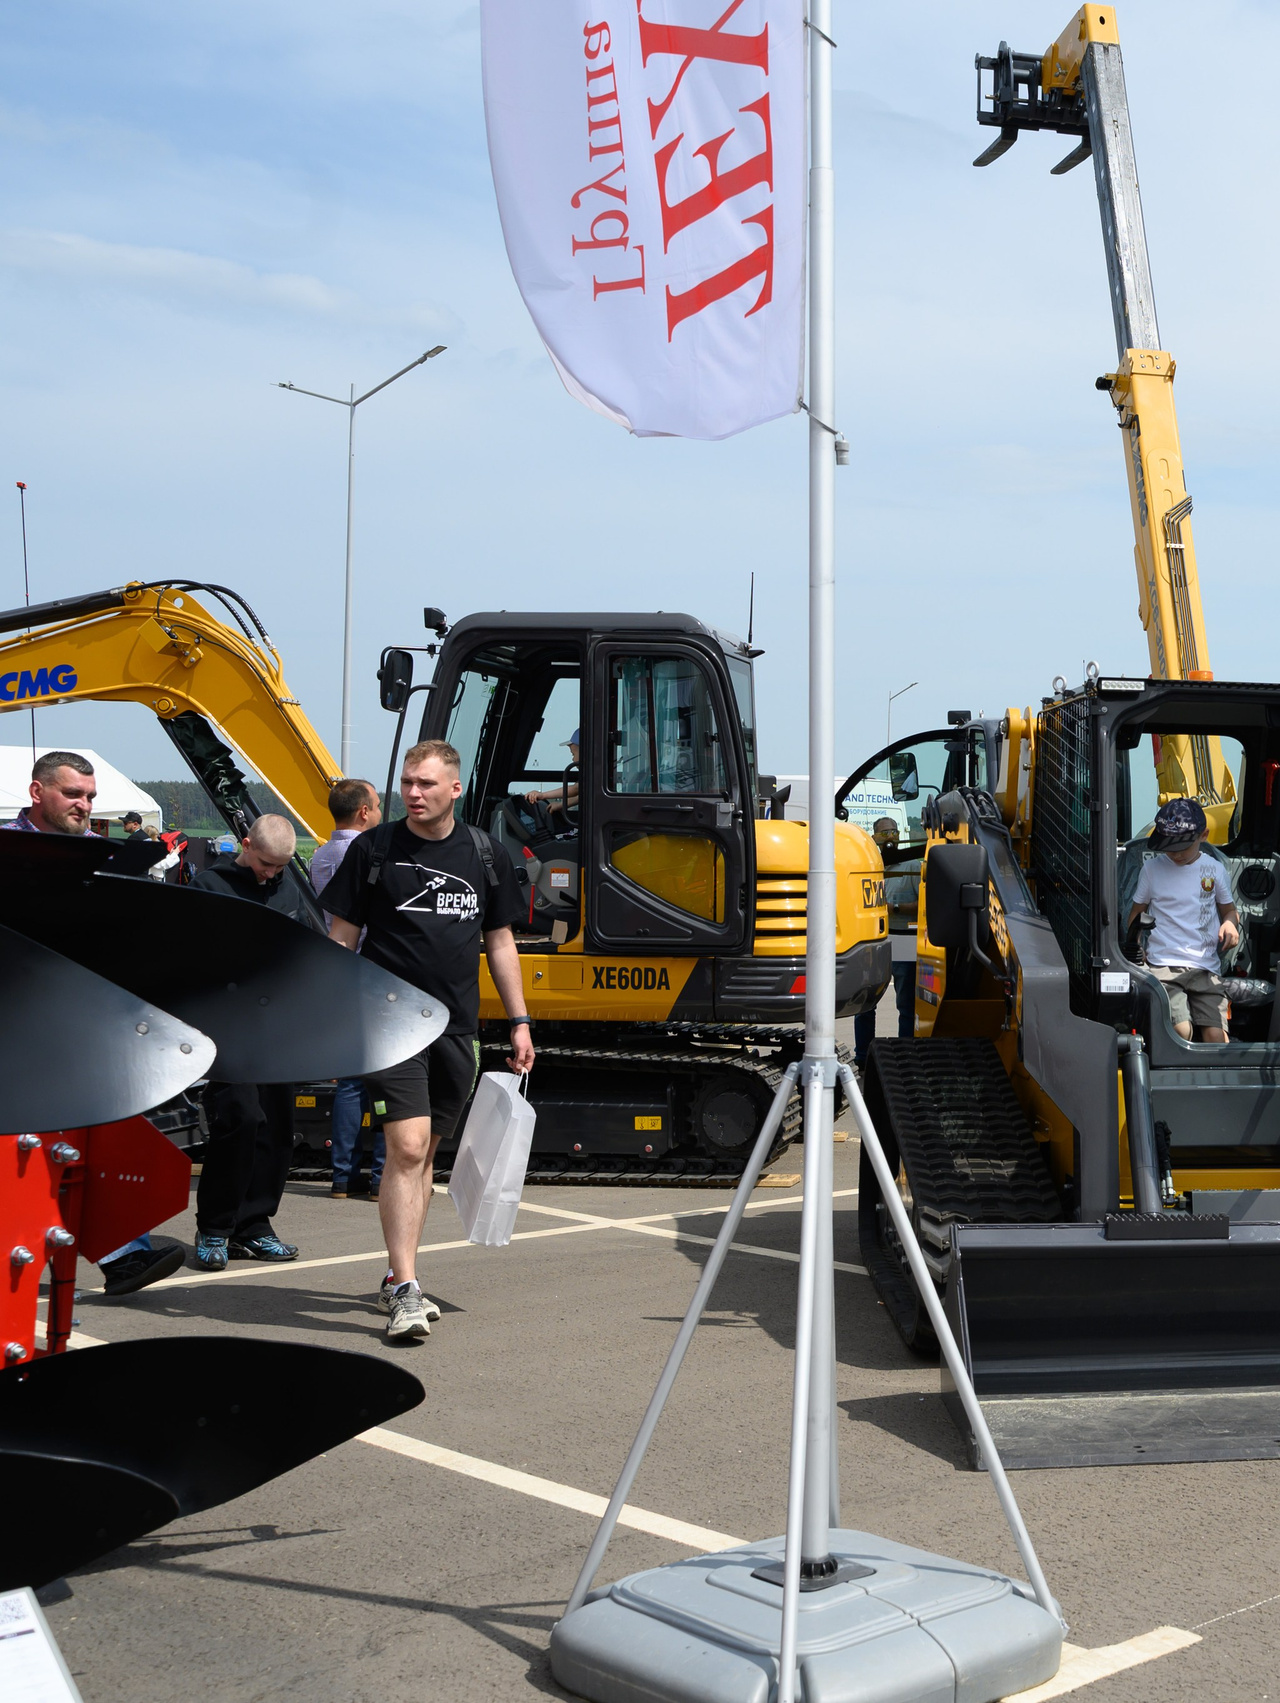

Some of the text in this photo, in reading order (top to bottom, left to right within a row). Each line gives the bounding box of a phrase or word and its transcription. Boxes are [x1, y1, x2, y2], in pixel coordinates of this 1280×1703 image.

[0, 664, 78, 702] CMG
[436, 892, 478, 908] ВРЕМЯ
[592, 966, 671, 990] XE60DA
